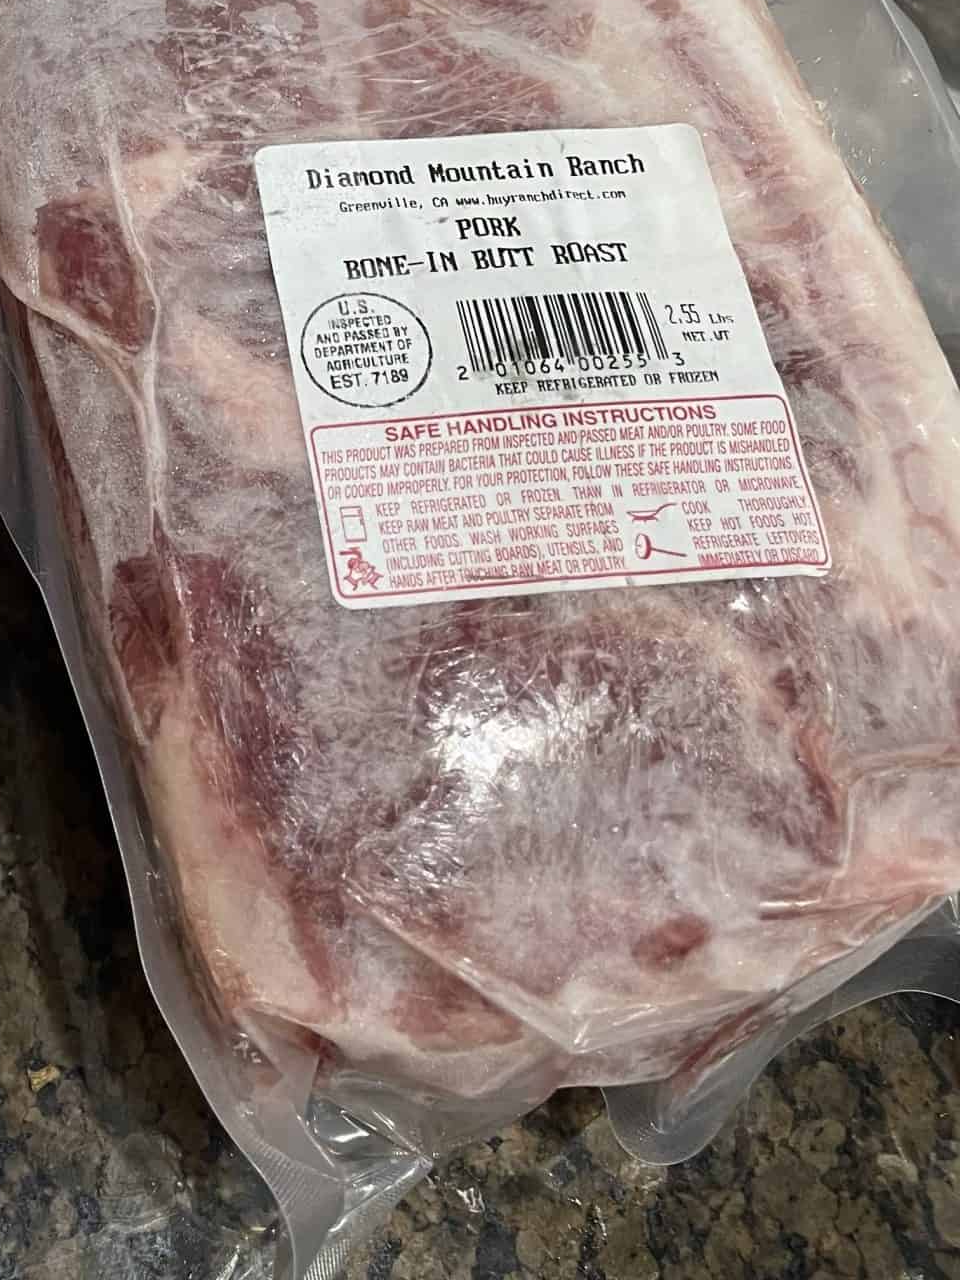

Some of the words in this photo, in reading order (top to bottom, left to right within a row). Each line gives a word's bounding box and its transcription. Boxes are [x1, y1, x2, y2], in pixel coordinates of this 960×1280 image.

[305, 163, 415, 191] Diamond
[428, 156, 554, 185] Mountain
[566, 151, 646, 177] Ranch
[338, 196, 424, 214] Greenville,
[431, 196, 448, 207] CA
[455, 215, 521, 240] PORK
[344, 252, 458, 279] BONE-IN
[471, 246, 537, 270] BUTT
[550, 239, 630, 265] ROAST
[337, 299, 374, 315] U.S.
[327, 315, 392, 329] INSPECTED
[315, 332, 340, 344] AND
[343, 328, 390, 342] PASSED
[392, 326, 409, 337] BY
[313, 341, 394, 358] DEPARTMENT
[396, 338, 413, 350] OF
[325, 353, 410, 370] AGRICULTURE
[456, 365, 469, 381] 2
[494, 358, 565, 378] 01064
[577, 352, 648, 371] 00255
[671, 351, 686, 365] 3
[329, 373, 367, 389] EST.
[372, 369, 409, 385] 7189
[494, 381, 529, 395] KEEP
[536, 374, 638, 392] REFRIGERATED
[642, 372, 662, 385] OR
[667, 369, 720, 383] FROZEN
[384, 423, 441, 441] SAFE
[445, 413, 557, 435] HANDLING
[562, 402, 716, 428] INSTRUCTIONS
[320, 450, 343, 464] THIS
[345, 446, 393, 462] PRODUCT
[393, 444, 417, 458] WAS
[419, 439, 471, 456] PREPARED
[471, 436, 500, 451] FROM
[501, 432, 555, 449] INSPECTED
[556, 431, 578, 444] AND
[579, 428, 617, 443] PASSED
[618, 426, 646, 440] MEAT
[645, 424, 684, 439] AND/OR
[729, 421, 759, 436] SOME
[758, 419, 787, 435] FOOD
[323, 465, 377, 481] PRODUCTS
[378, 463, 401, 477] MAY
[403, 459, 446, 475] CONTAIN
[446, 454, 496, 471] BACTERIA
[497, 452, 524, 467] THAT
[524, 449, 559, 465] COULD
[559, 448, 593, 463] CAUSE
[594, 445, 636, 460] ILLNESS
[637, 444, 648, 457] IF
[648, 443, 668, 457] THE
[668, 440, 716, 457] PRODUCT
[715, 441, 728, 454] IS
[727, 437, 791, 455] MISHANDLED
[327, 485, 343, 500] OR
[343, 482, 385, 499] COOKED
[452, 475, 474, 489] FOR
[475, 472, 504, 487] YOUR
[570, 465, 613, 480] FOLLOW
[614, 463, 645, 478] THESE
[646, 461, 672, 476] SAFE
[671, 458, 722, 475] HANDLING
